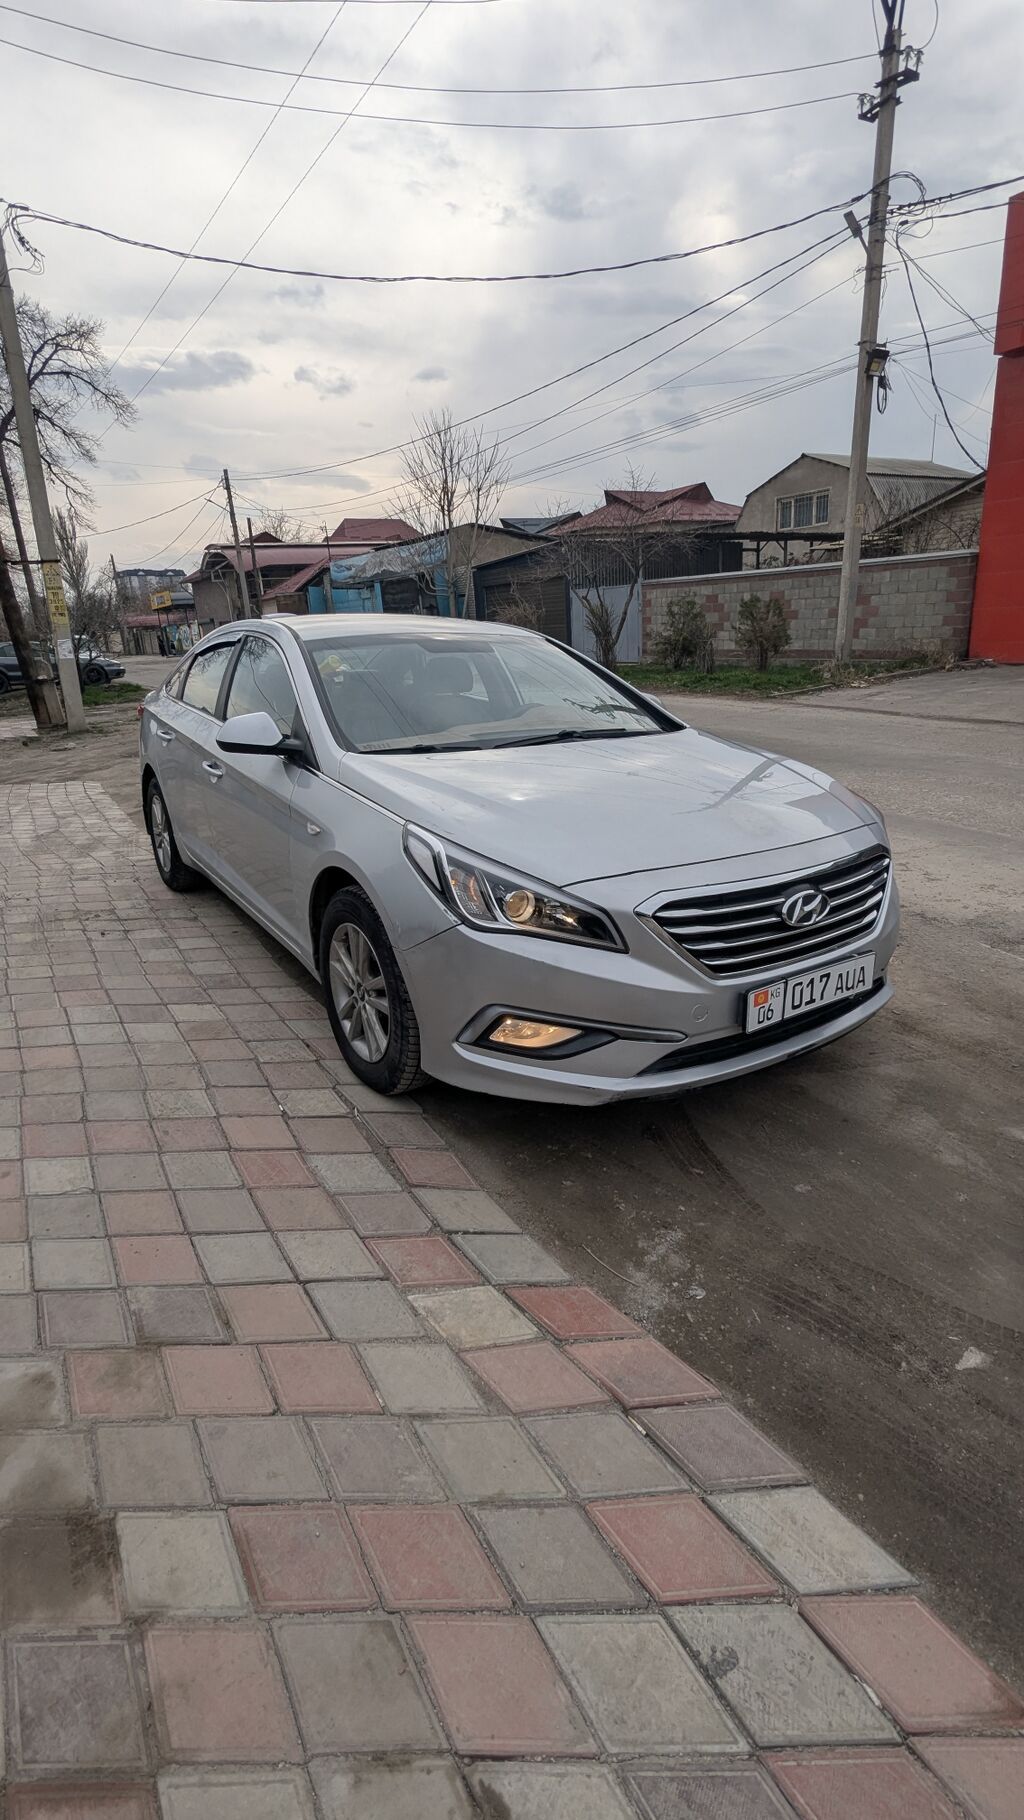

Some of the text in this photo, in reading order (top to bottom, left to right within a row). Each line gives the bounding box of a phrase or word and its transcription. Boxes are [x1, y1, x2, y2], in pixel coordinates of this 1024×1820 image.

[770, 987, 781, 1000] KG
[791, 966, 866, 1010] 017 AUA
[757, 1002, 774, 1024] 06
